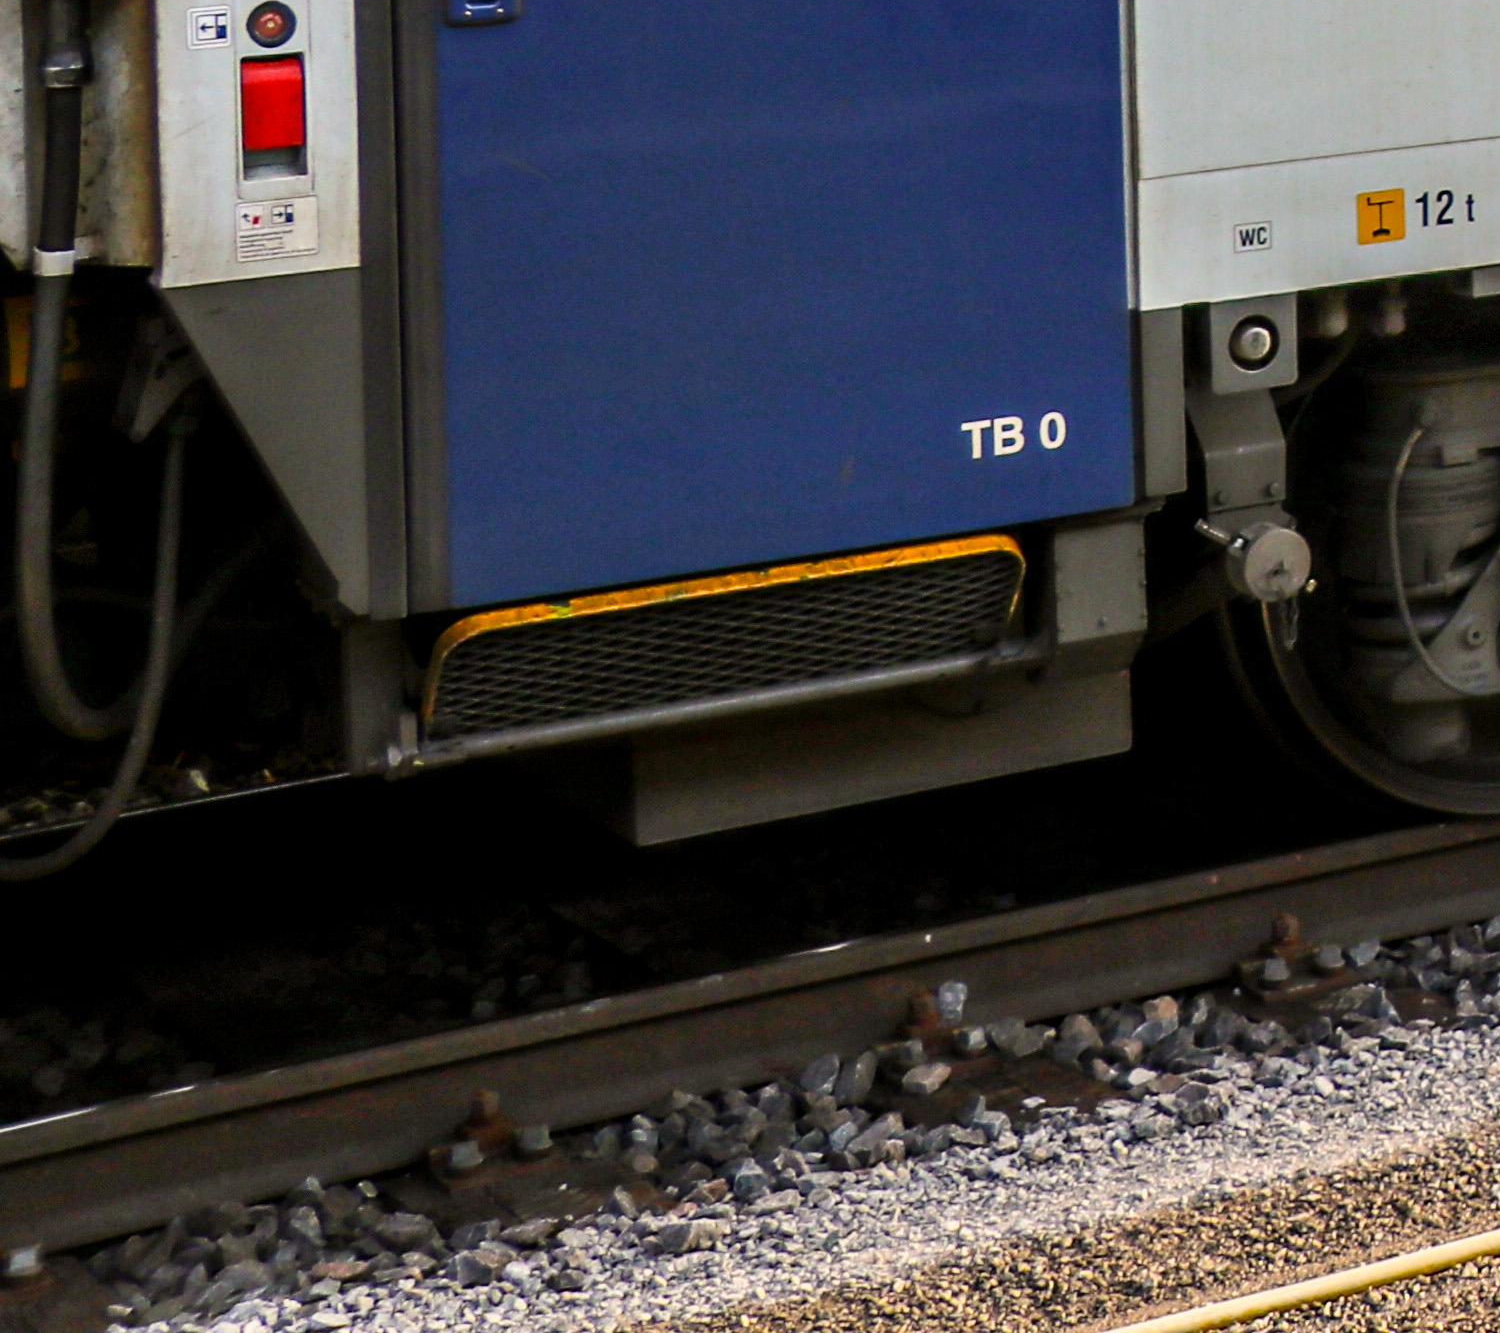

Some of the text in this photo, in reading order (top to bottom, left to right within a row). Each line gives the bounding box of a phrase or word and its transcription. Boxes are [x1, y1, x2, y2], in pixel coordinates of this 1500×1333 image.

[1415, 189, 1476, 228] 12 t
[1238, 226, 1269, 248] WC
[961, 411, 1067, 460] TB 0
